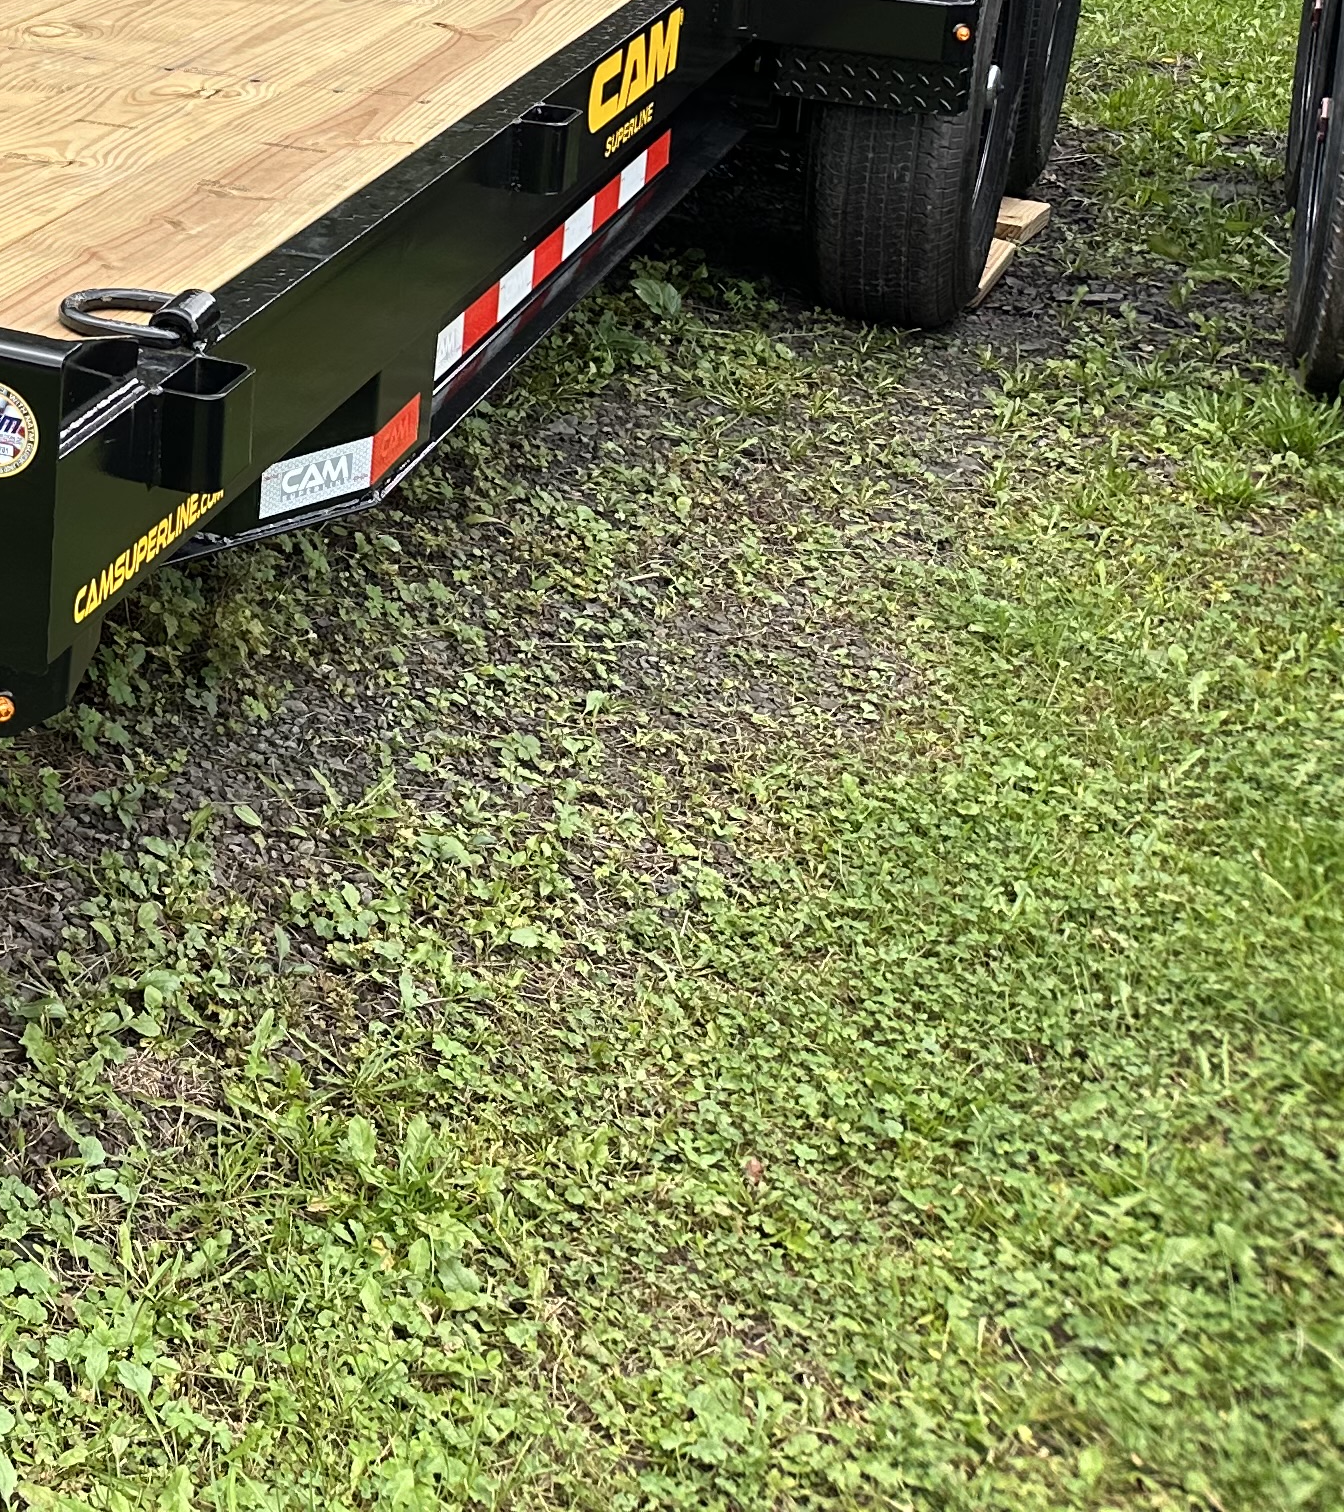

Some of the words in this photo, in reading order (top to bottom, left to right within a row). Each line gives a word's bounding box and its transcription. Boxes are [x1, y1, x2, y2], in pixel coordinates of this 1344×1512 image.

[588, 6, 682, 134] CAM
[604, 102, 654, 158] SUPERLINE
[281, 455, 349, 494] CAM
